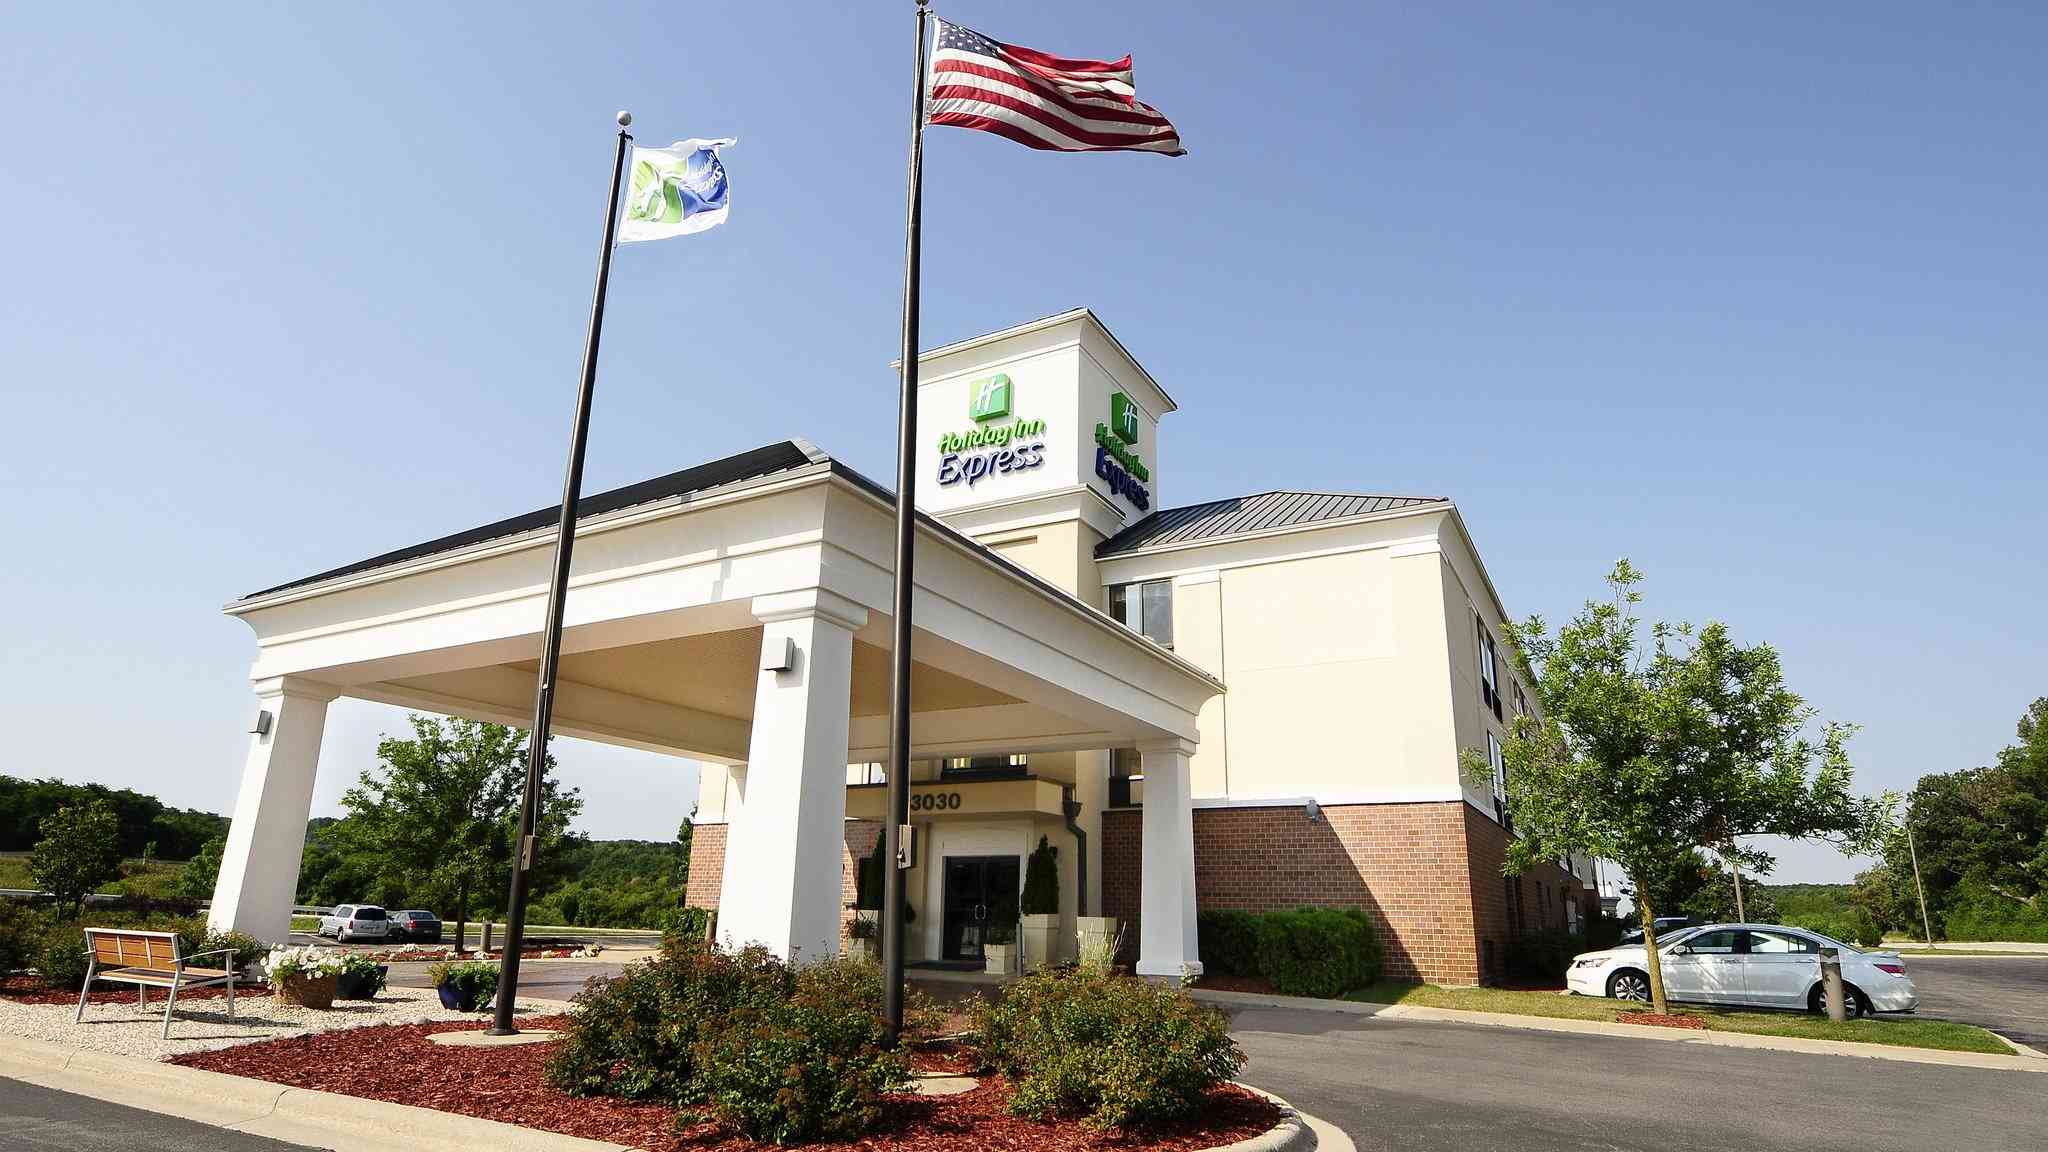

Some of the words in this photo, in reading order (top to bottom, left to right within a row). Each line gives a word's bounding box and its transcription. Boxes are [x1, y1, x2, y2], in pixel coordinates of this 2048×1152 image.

[938, 424, 1010, 454] Holiday
[1010, 417, 1047, 439] Inn
[936, 441, 1045, 487] Express
[910, 792, 961, 811] 3030
